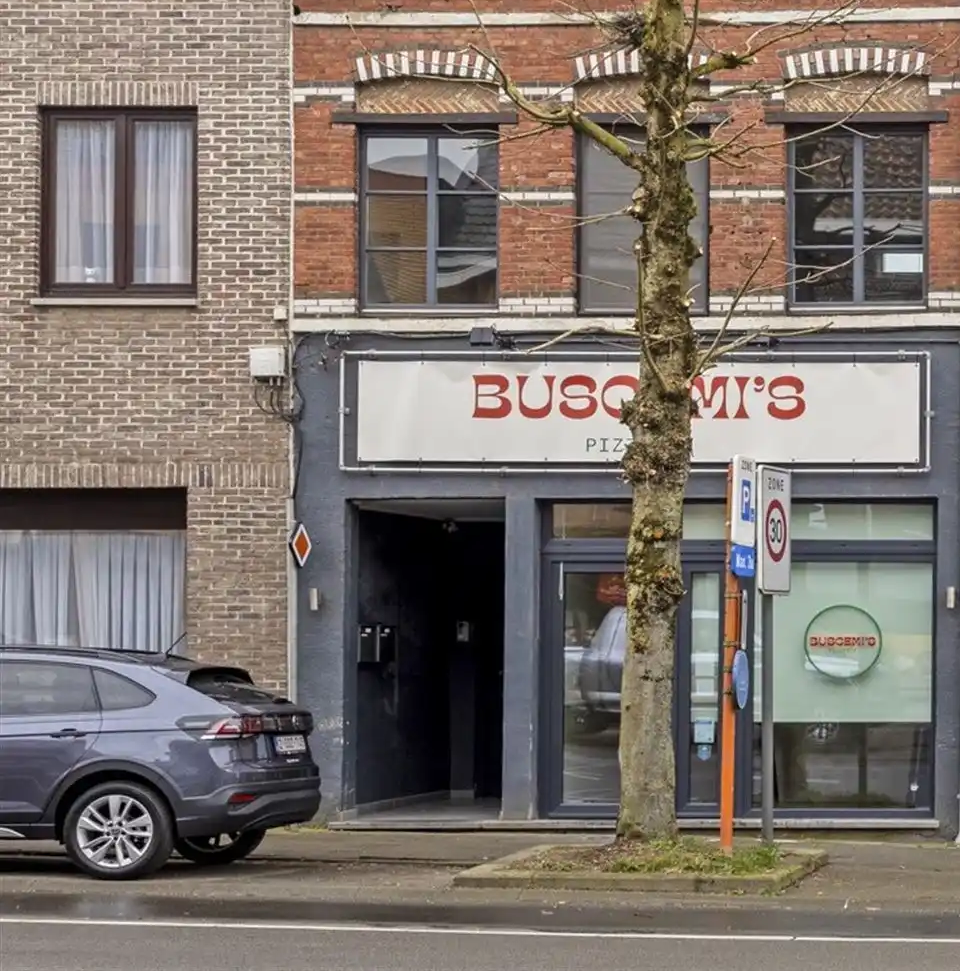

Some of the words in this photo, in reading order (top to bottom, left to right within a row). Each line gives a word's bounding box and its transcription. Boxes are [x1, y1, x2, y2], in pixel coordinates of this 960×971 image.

[472, 374, 806, 420] BUSCMI'S
[767, 476, 785, 493] ZONE
[769, 517, 783, 543] 30
